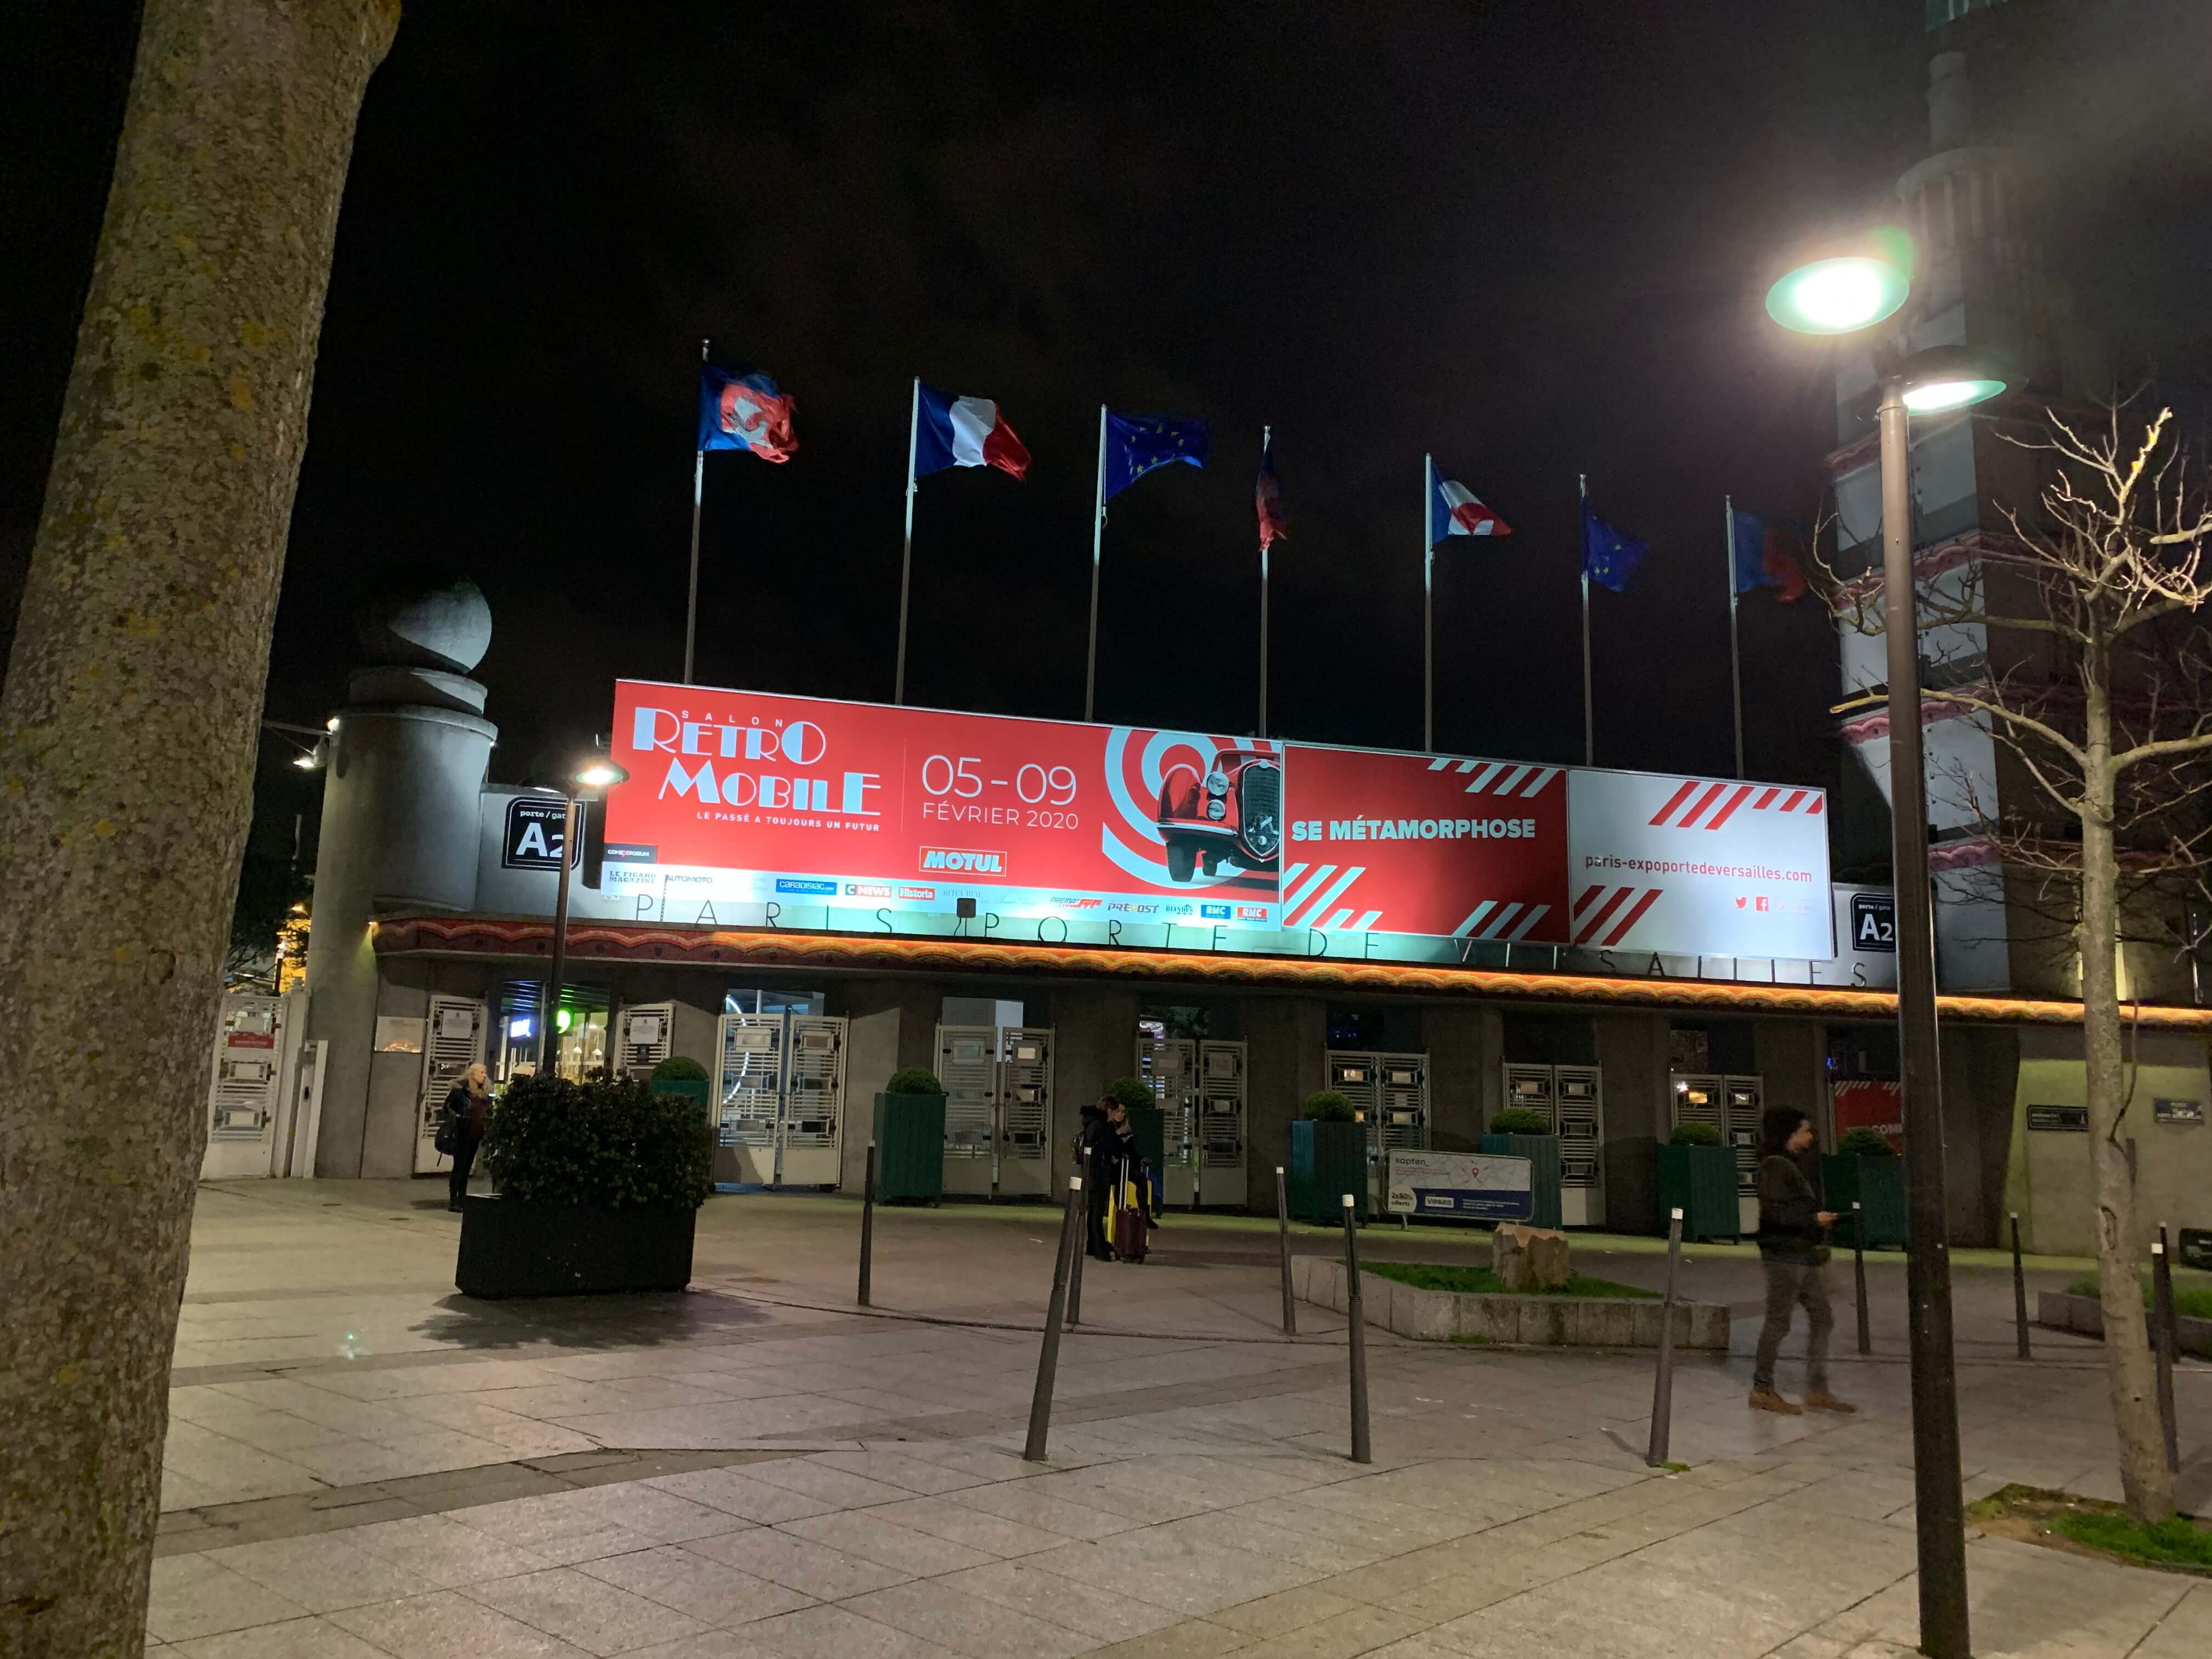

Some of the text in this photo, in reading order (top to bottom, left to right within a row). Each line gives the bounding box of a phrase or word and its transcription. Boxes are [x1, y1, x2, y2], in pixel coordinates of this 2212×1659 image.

[682, 710, 783, 727] SALON
[633, 707, 826, 765] RETRO
[658, 756, 881, 816] MOBILE
[697, 812, 710, 820] LE
[715, 812, 750, 822] PASSÉ
[766, 816, 821, 828] TOUJOURS
[827, 821, 840, 829] UN
[845, 822, 880, 832] FUTUR
[923, 800, 1078, 830] FÉVRIER 2020
[1291, 814, 1536, 842] SE MÉTAMORPHOSE
[516, 822, 563, 858] A2
[923, 850, 1002, 873] MOTUL
[1585, 855, 1813, 883] paris-expoportedeversailles.com
[899, 887, 933, 899] Historia
[636, 894, 893, 934] PARIS
[985, 912, 1227, 951] PORTE
[1205, 905, 1226, 915] RMC
[1242, 907, 1262, 917] RMC
[1860, 913, 1893, 941] A2
